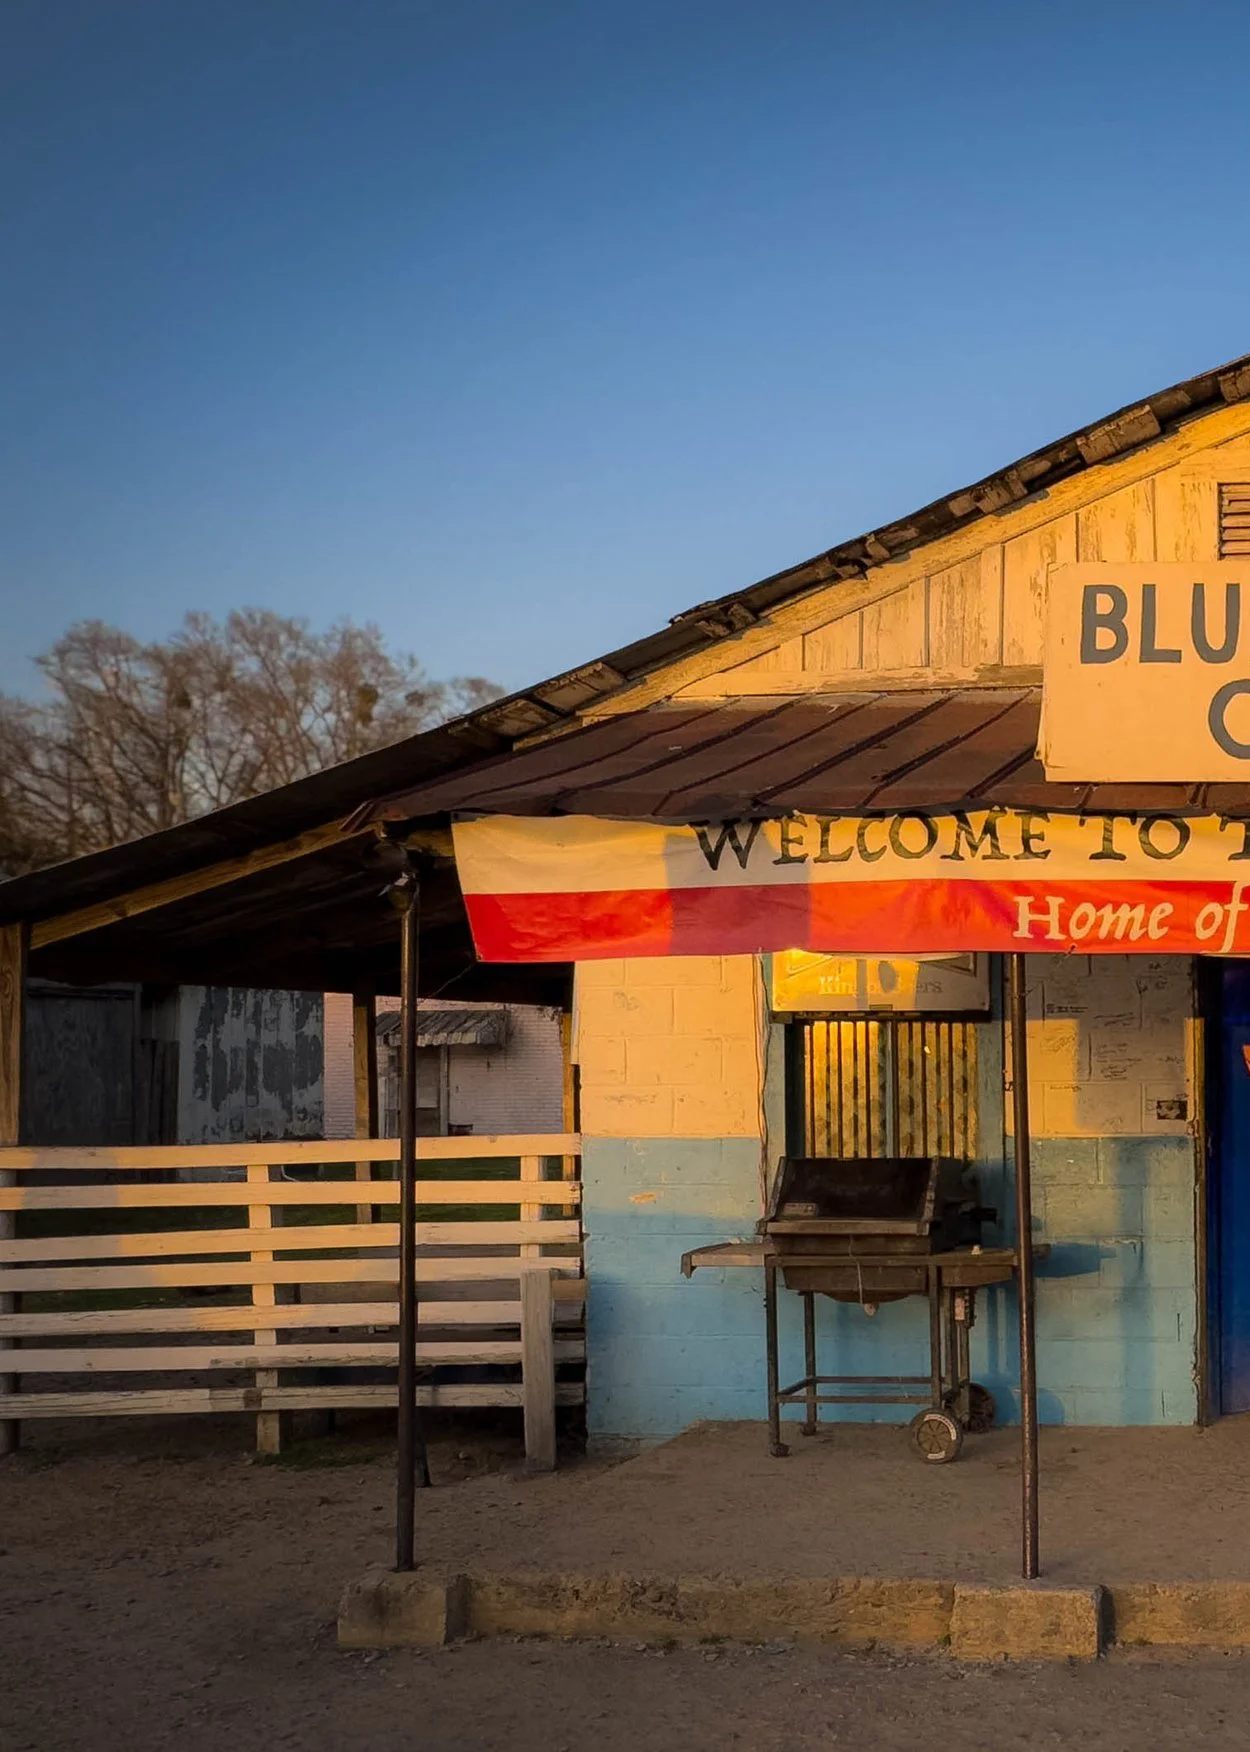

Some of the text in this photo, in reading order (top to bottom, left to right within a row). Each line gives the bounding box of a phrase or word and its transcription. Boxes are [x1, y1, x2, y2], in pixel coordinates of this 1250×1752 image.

[688, 808, 1052, 871] WELCOME
[1079, 811, 1191, 860] TO
[1012, 895, 1174, 941] Home
